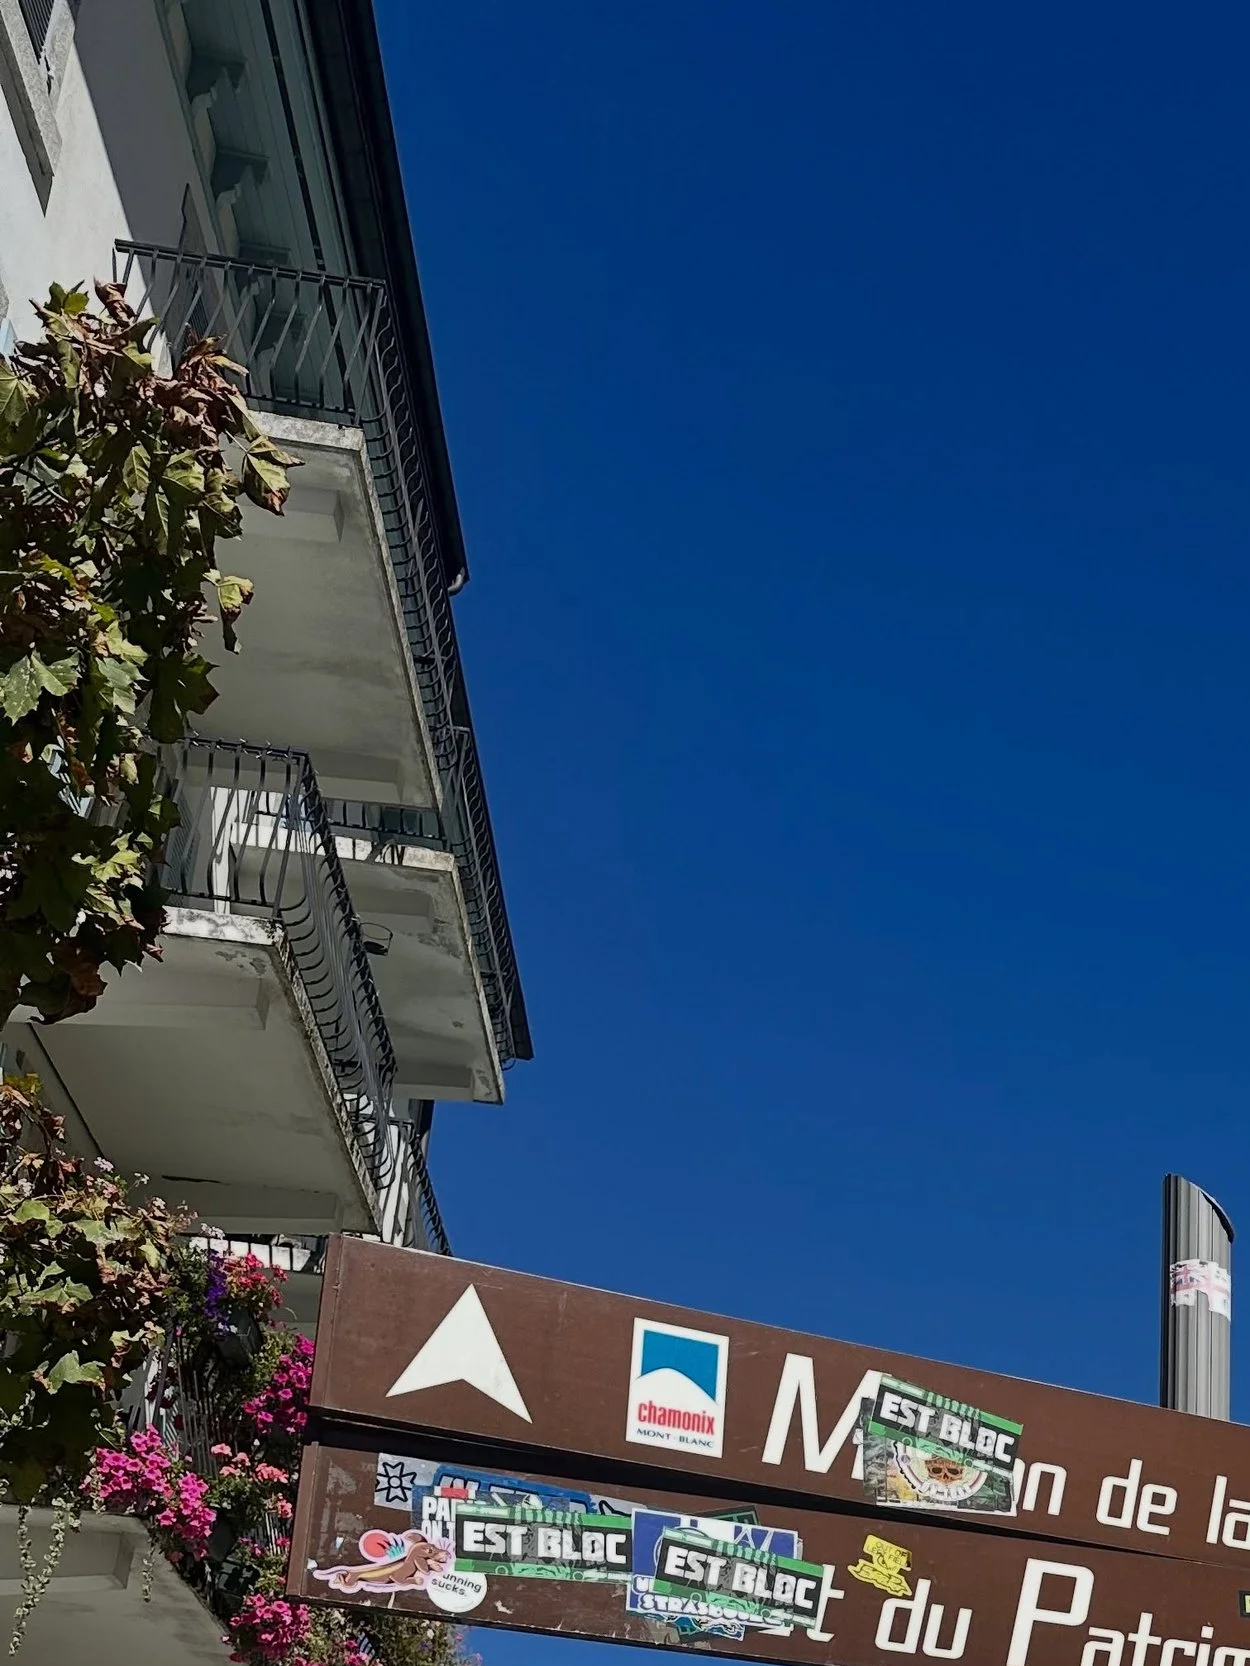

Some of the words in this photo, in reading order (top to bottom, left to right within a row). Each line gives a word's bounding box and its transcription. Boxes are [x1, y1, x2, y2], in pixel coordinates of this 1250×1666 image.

[637, 1400, 715, 1435] chamonix
[879, 1391, 936, 1433] EST
[938, 1413, 1015, 1463] BLOC
[1095, 1458, 1178, 1536] de
[463, 1520, 529, 1556] EST
[537, 1526, 627, 1565] BLOC
[442, 1573, 482, 1592] unning
[664, 1545, 728, 1586] EST
[731, 1562, 817, 1610] BLOC
[875, 1578, 973, 1660] du
